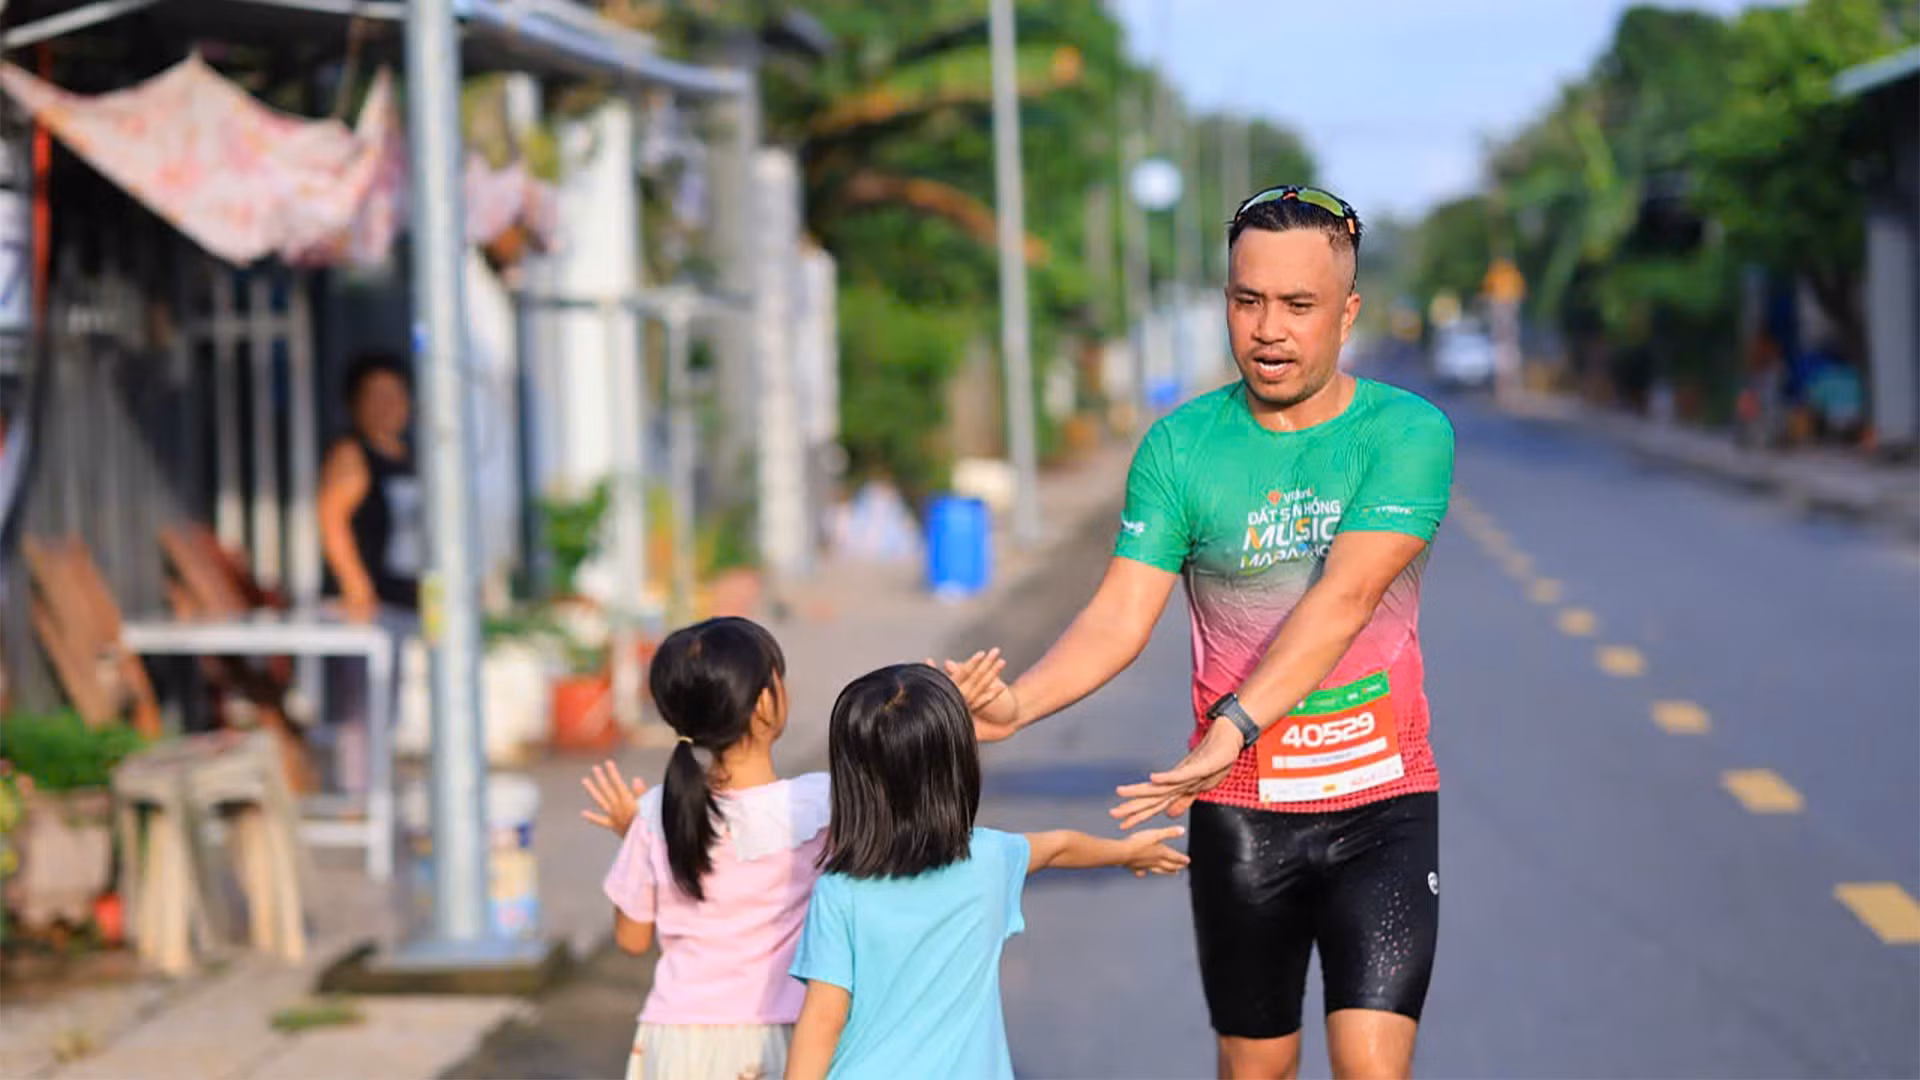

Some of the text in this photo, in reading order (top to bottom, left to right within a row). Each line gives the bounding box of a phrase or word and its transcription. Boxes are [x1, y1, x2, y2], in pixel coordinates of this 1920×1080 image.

[1280, 503, 1302, 521] SN
[1243, 516, 1341, 551] MUSIC
[1281, 711, 1376, 748] 40529
